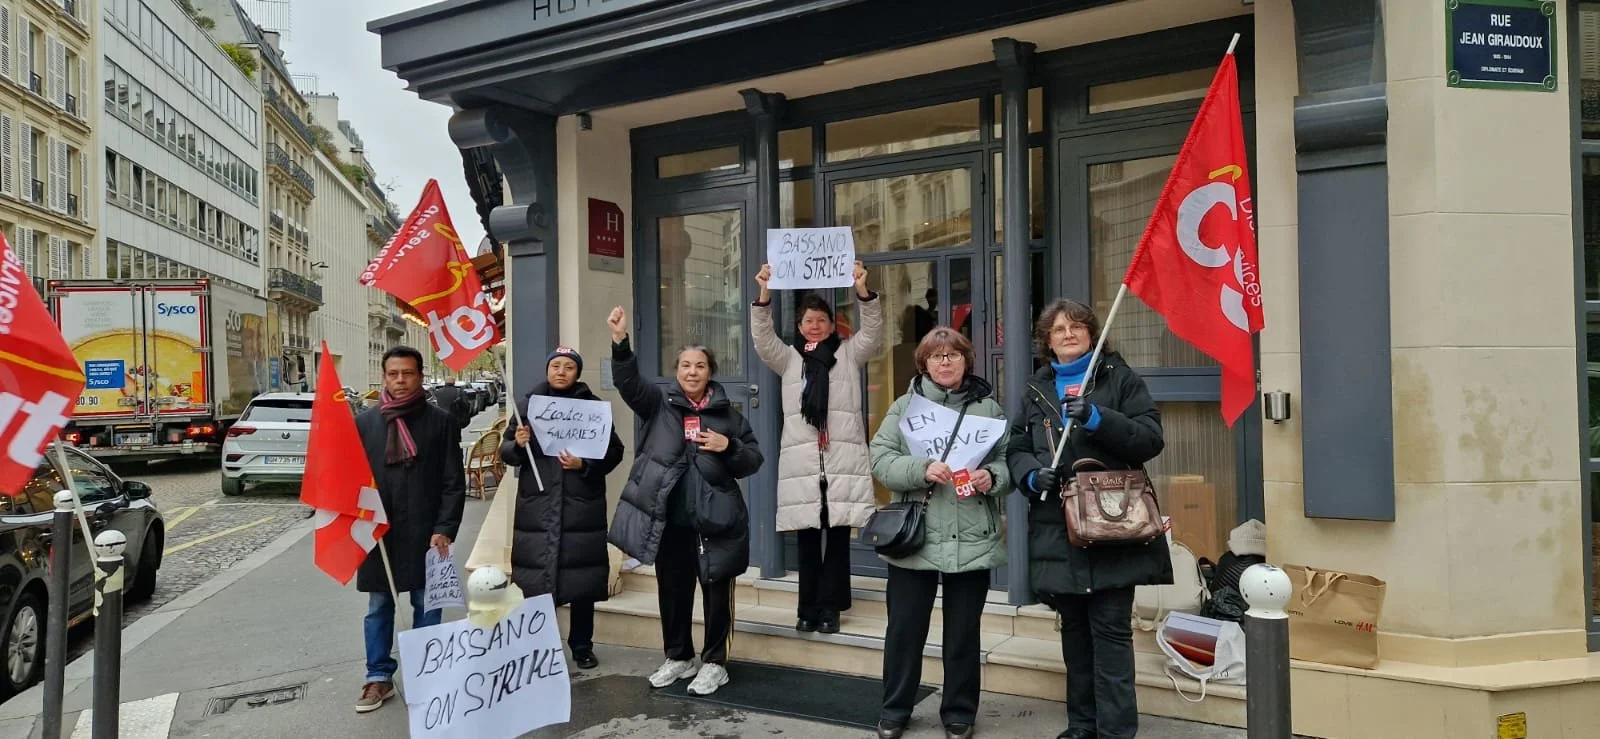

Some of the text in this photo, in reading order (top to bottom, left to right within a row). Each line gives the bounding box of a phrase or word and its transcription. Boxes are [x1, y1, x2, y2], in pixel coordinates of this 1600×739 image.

[1490, 14, 1511, 27] RUE
[1460, 32, 1543, 49] JEAN GIRAUDOUX
[607, 212, 620, 232] H
[778, 232, 847, 255] BASSANO
[776, 254, 847, 280] ON STRIKE
[157, 302, 196, 317] Sysco
[89, 396, 98, 405] 90
[906, 412, 936, 432] EN
[955, 481, 976, 496] cgt
[1334, 619, 1353, 627] LOVE
[416, 610, 546, 678] BASSANO
[425, 648, 563, 730] ON STRIKE
